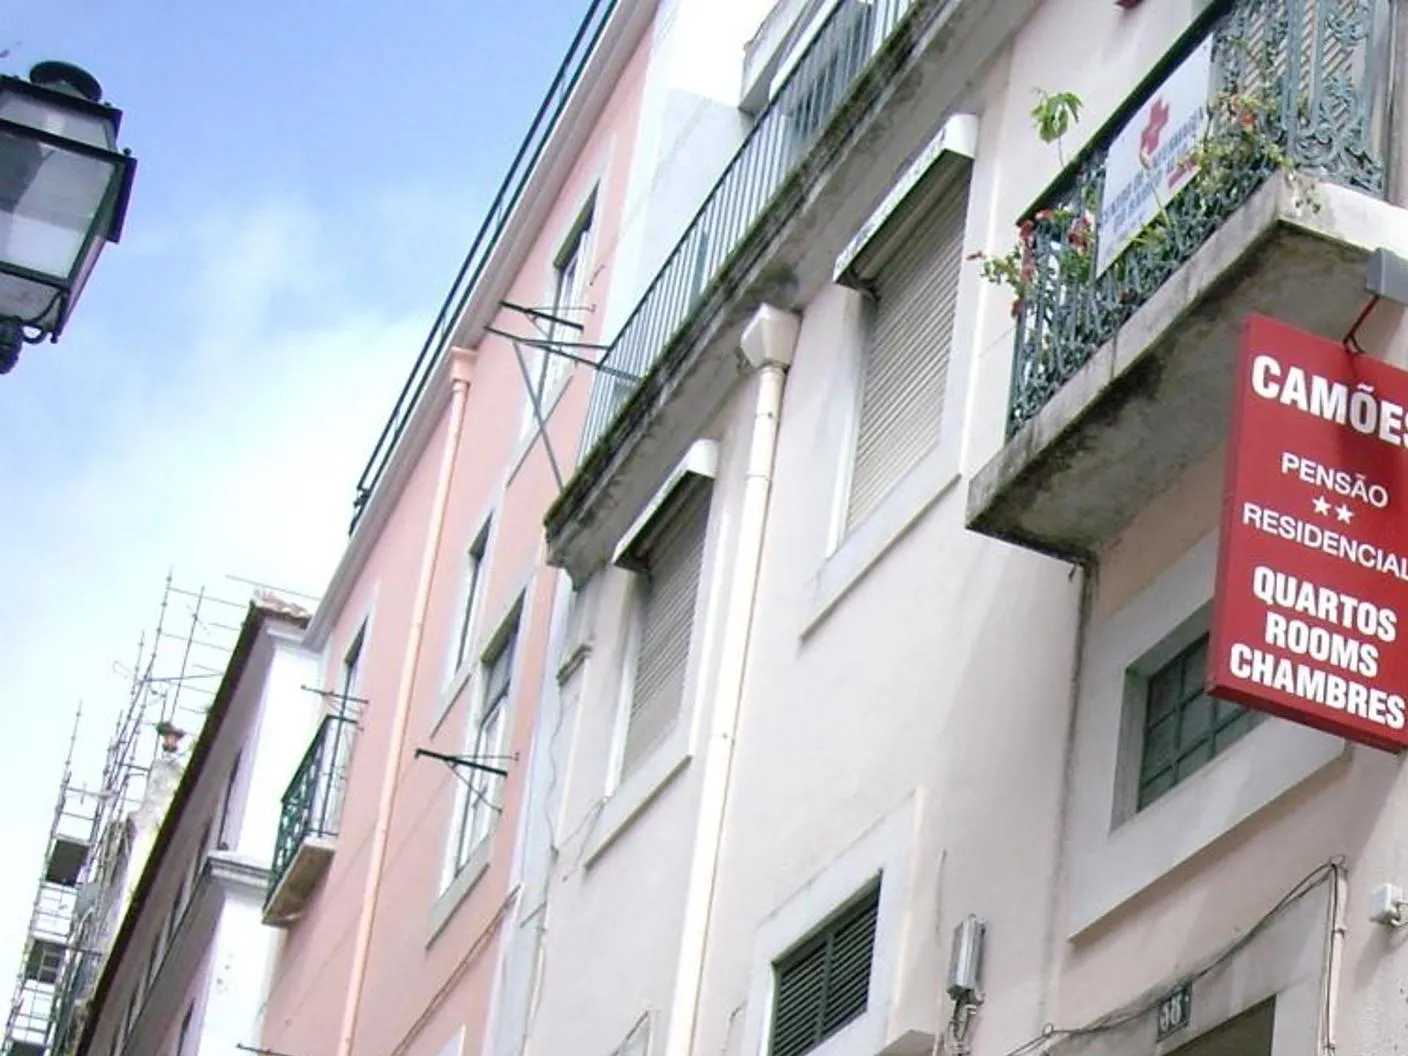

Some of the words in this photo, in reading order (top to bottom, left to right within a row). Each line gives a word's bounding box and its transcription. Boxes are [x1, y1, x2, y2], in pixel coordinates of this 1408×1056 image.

[1281, 451, 1389, 509] PENSÃO
[1253, 566, 1398, 642] QUARTOS
[1265, 612, 1379, 678] ROOMS
[1230, 643, 1406, 730] CHAMBRES
